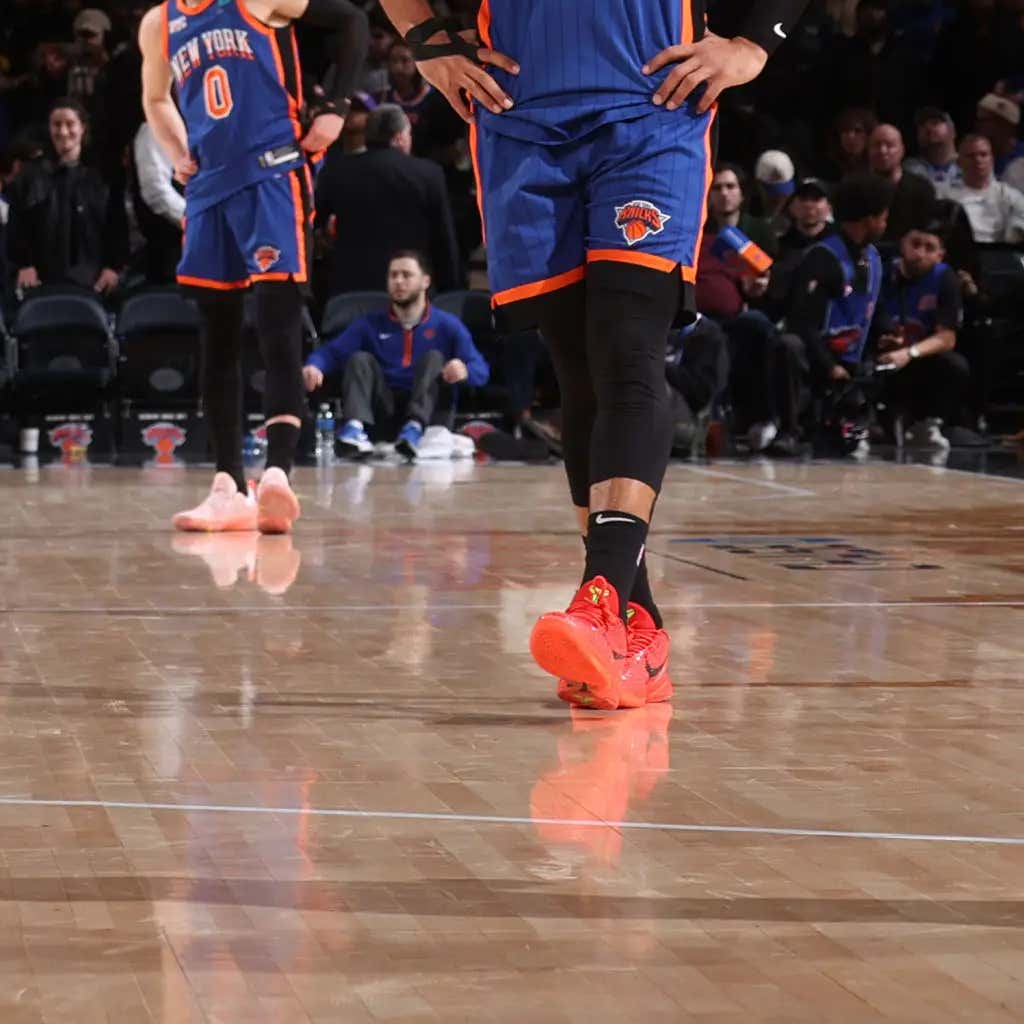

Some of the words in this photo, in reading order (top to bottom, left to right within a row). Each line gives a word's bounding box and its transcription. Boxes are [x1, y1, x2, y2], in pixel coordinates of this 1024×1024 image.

[170, 36, 201, 87] NEW
[201, 28, 255, 61] YORK
[203, 64, 234, 120] 0
